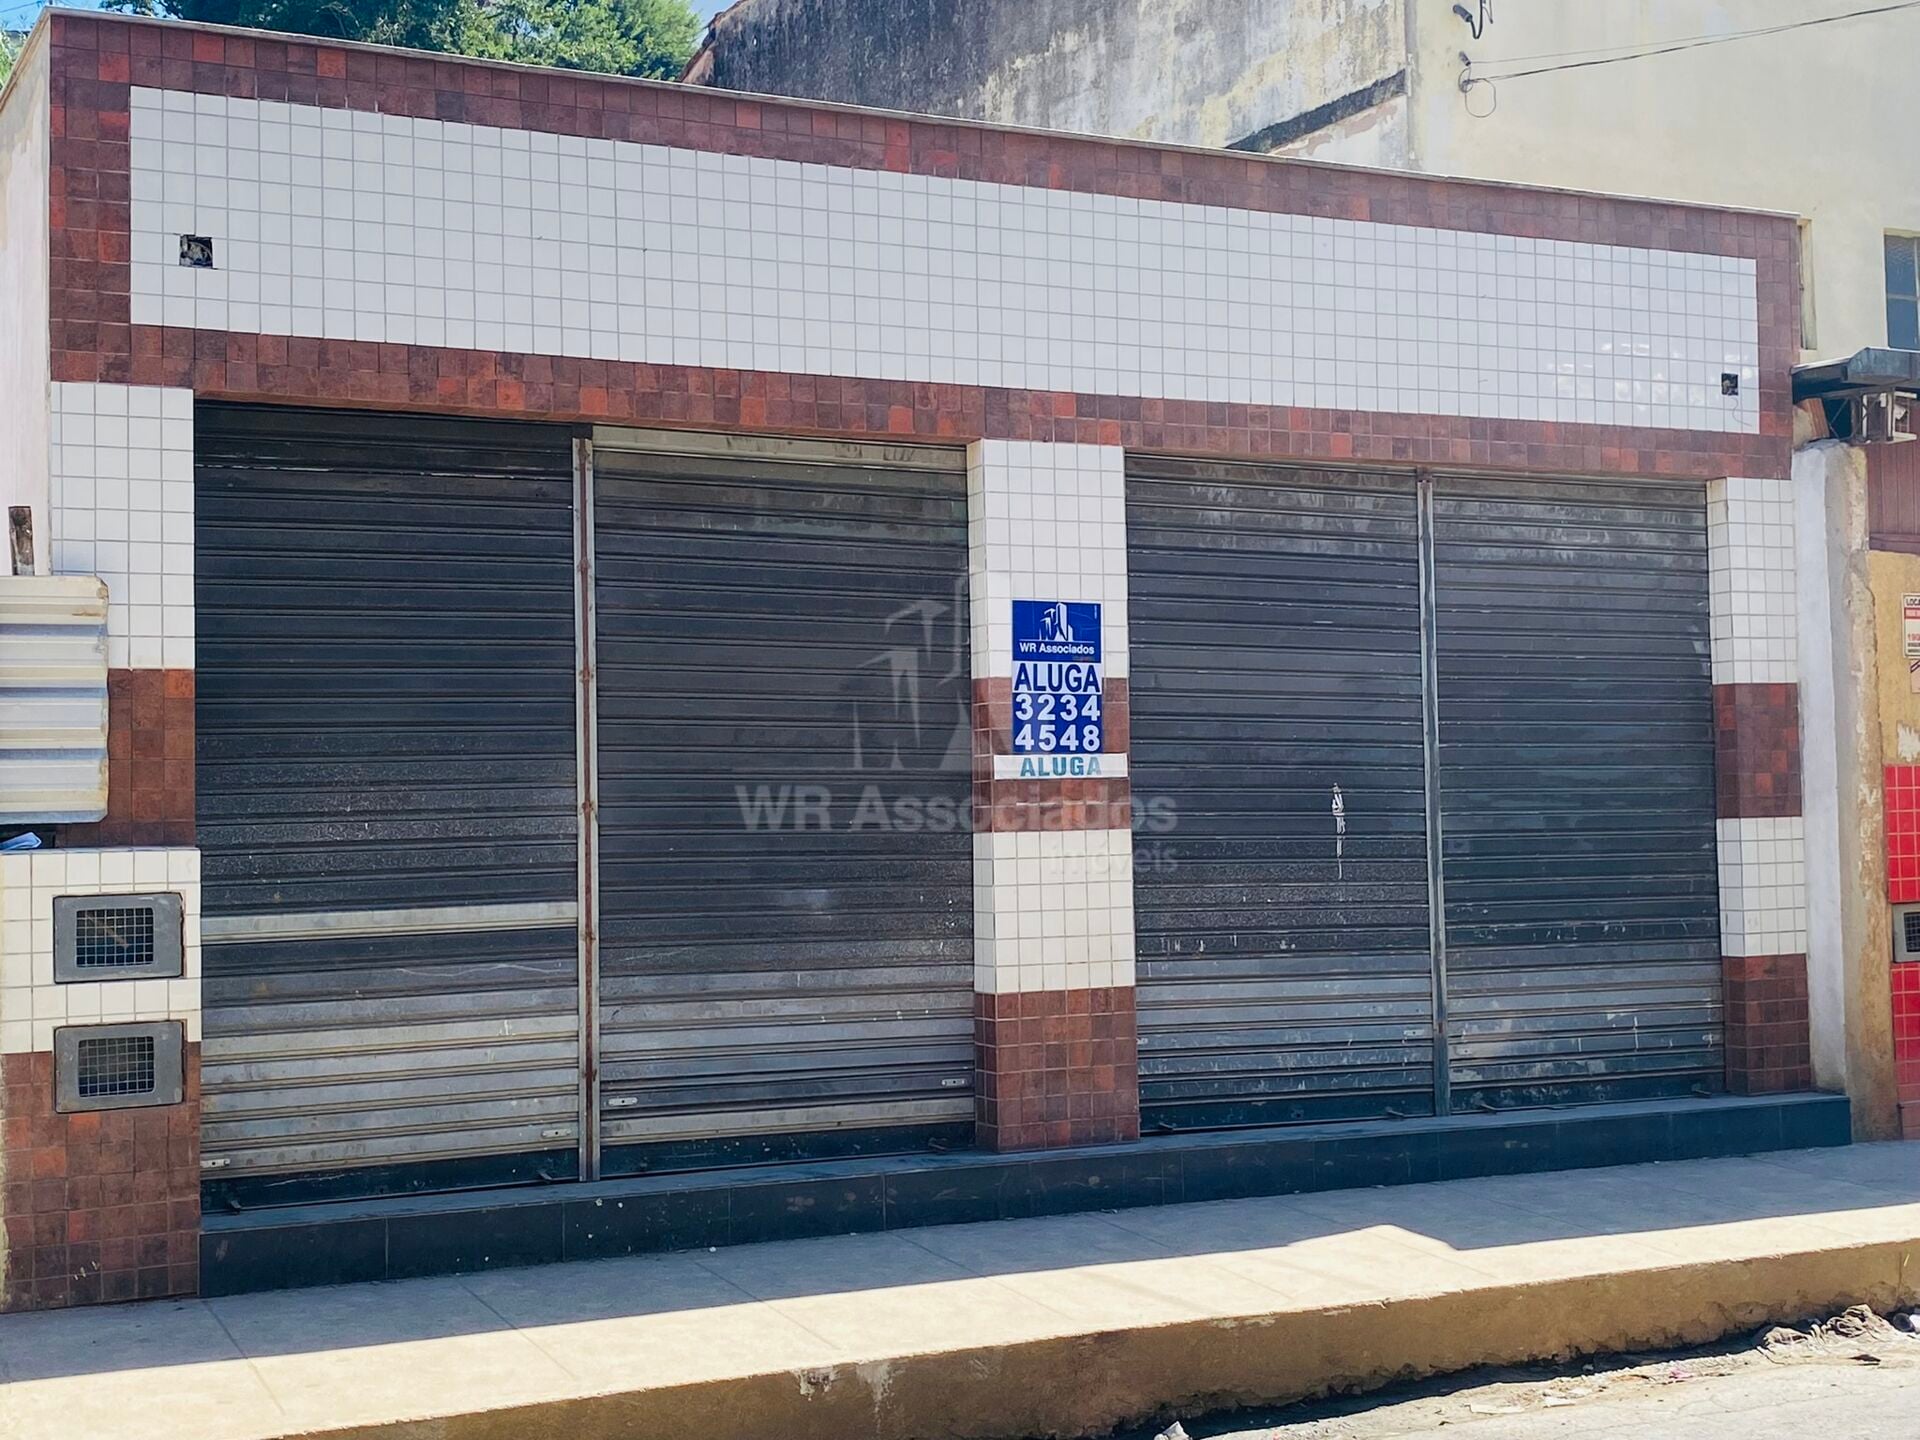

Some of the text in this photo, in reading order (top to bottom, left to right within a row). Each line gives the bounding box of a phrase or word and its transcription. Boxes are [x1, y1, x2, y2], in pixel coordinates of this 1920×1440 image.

[1019, 642, 1095, 655] WR Associados
[1014, 663, 1100, 692] ALUGA
[1015, 694, 1100, 721] 3234
[1015, 724, 1100, 751] 4548
[1020, 757, 1102, 777] ALUGA
